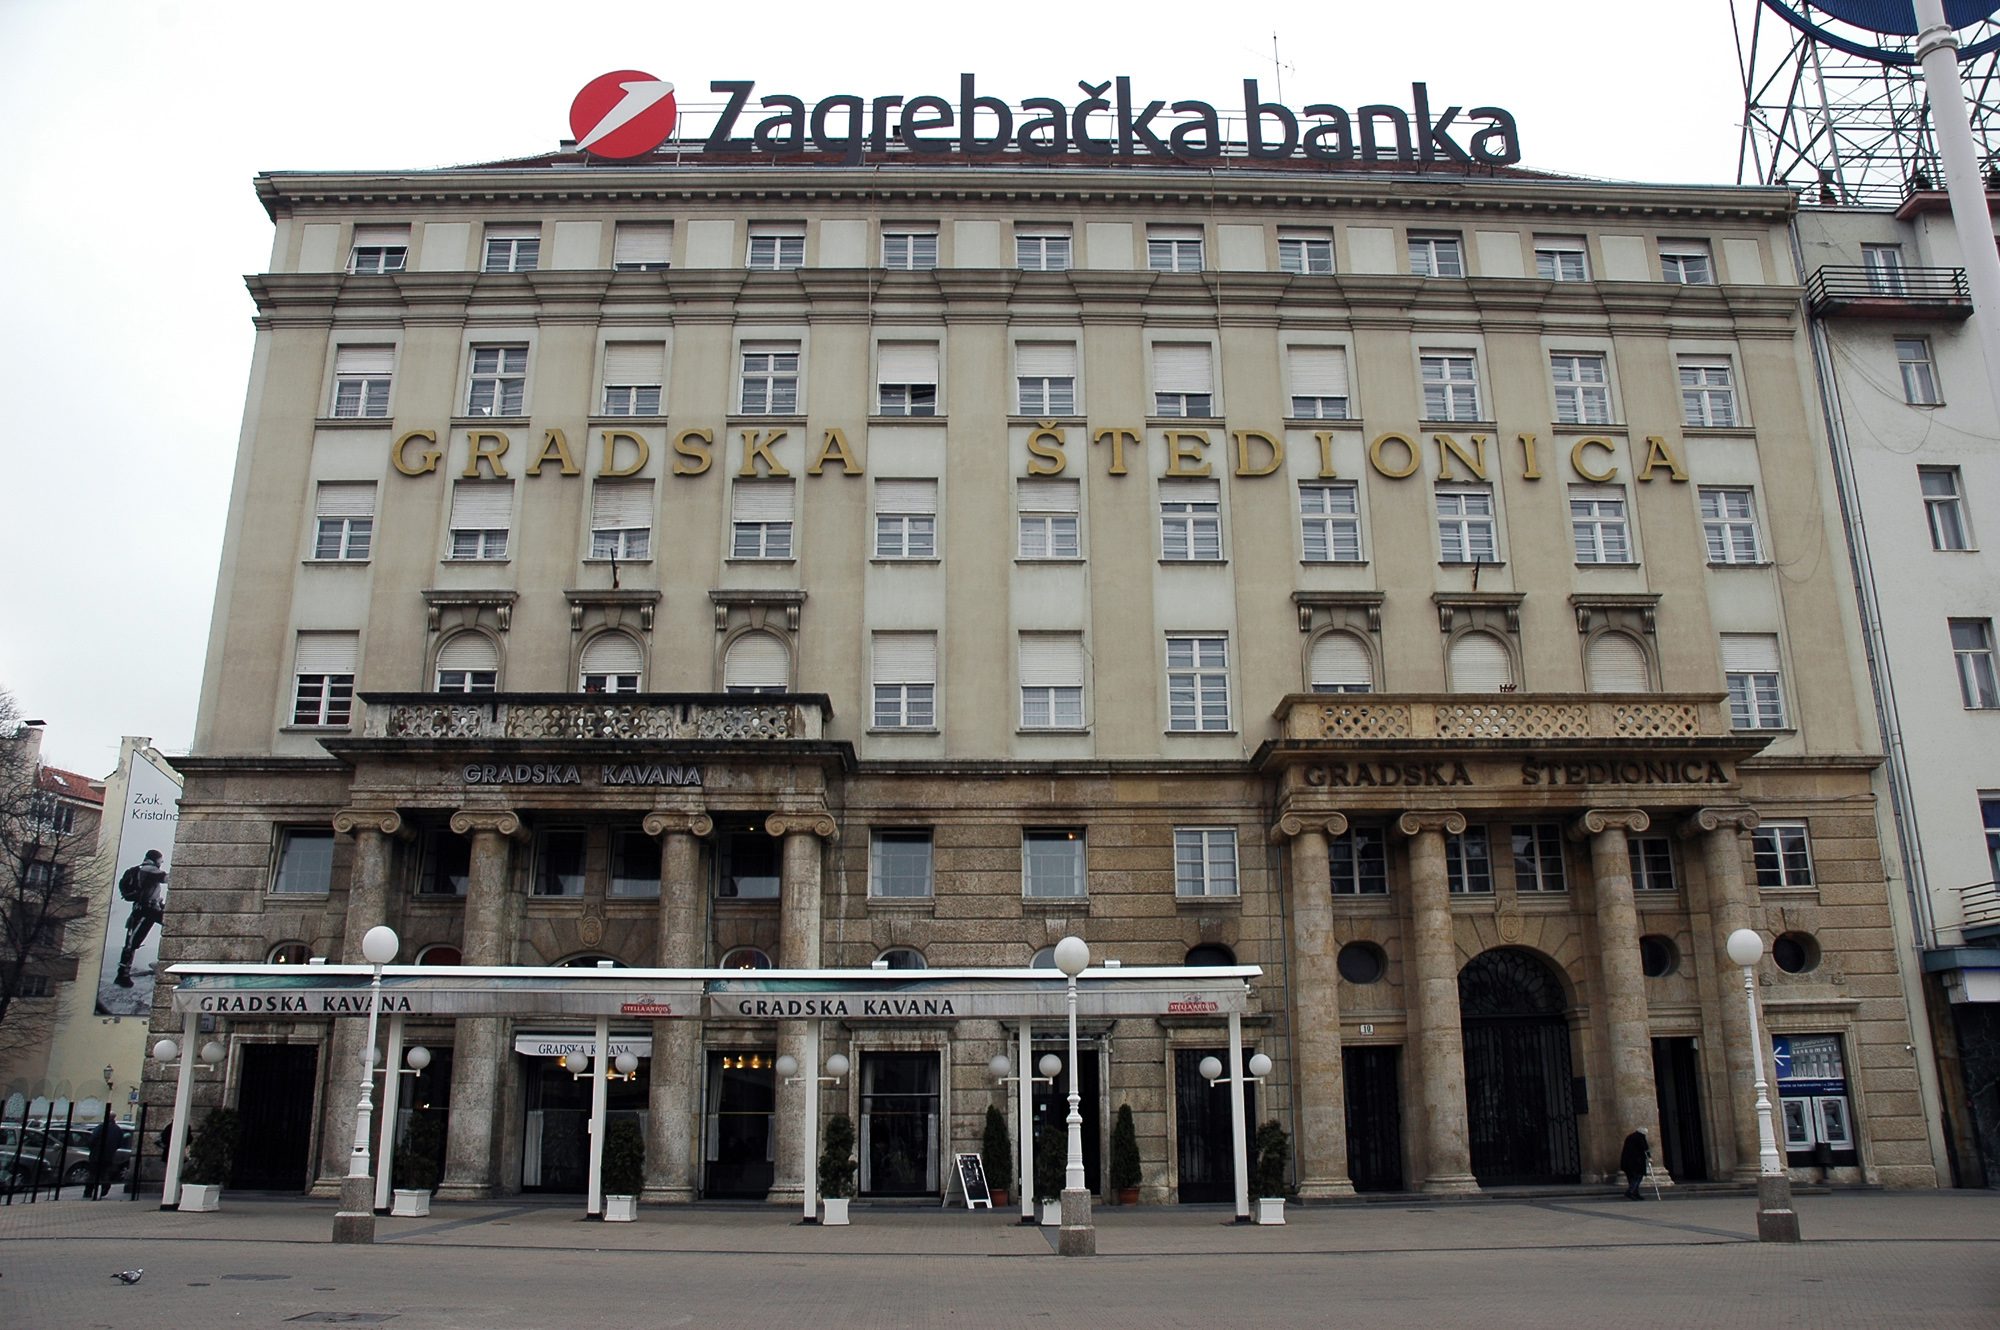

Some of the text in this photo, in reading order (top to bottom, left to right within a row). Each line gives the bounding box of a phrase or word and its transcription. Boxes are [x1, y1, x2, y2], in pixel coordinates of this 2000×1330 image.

[702, 73, 1522, 167] Zagrebačka banka
[391, 420, 1689, 481] GRADSKA ŠTEDIONICA
[462, 764, 702, 786] GRADSKA KAVANA
[1303, 755, 1729, 787] GRADSKA ŠTEDIONICA
[134, 793, 163, 805] Zvuk.
[201, 996, 308, 1012] GRADSKA
[739, 1000, 955, 1016] GRADSKA KAVANA
